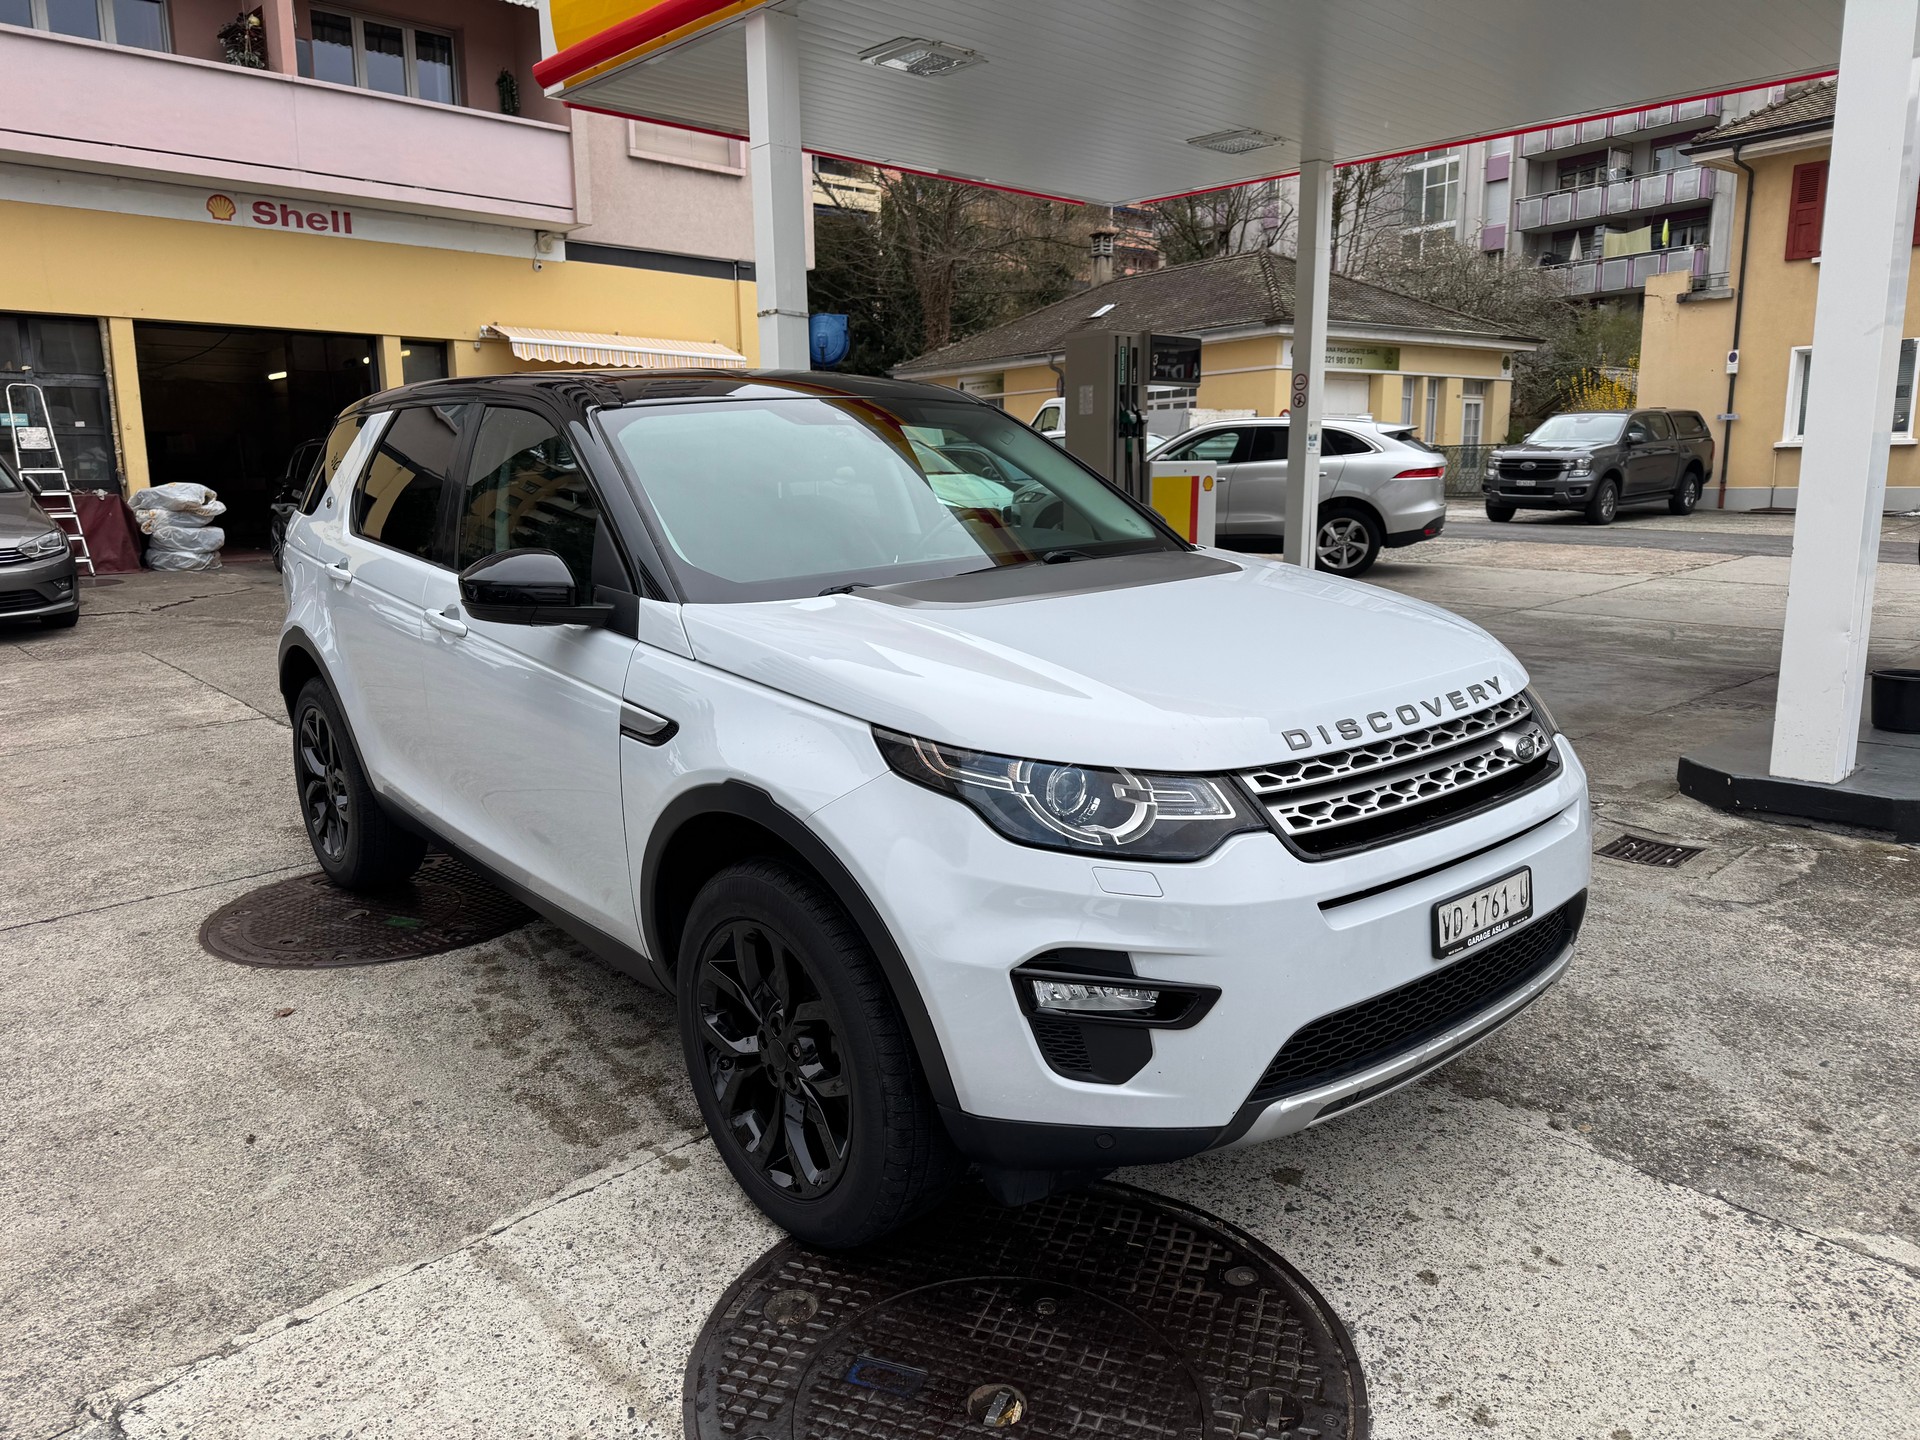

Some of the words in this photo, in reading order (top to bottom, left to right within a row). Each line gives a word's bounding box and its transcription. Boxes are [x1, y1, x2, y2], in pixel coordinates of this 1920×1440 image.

[252, 201, 353, 234] Shell
[1152, 353, 1159, 366] 3
[1336, 356, 1347, 364] 981
[1356, 357, 1363, 365] 71
[1281, 676, 1502, 751] DISCOVERY
[1442, 907, 1463, 943] VD
[1471, 884, 1509, 928] 1761
[1519, 874, 1528, 906] U
[1467, 930, 1491, 947] GARAGE
[1491, 921, 1510, 935] ASLAN
